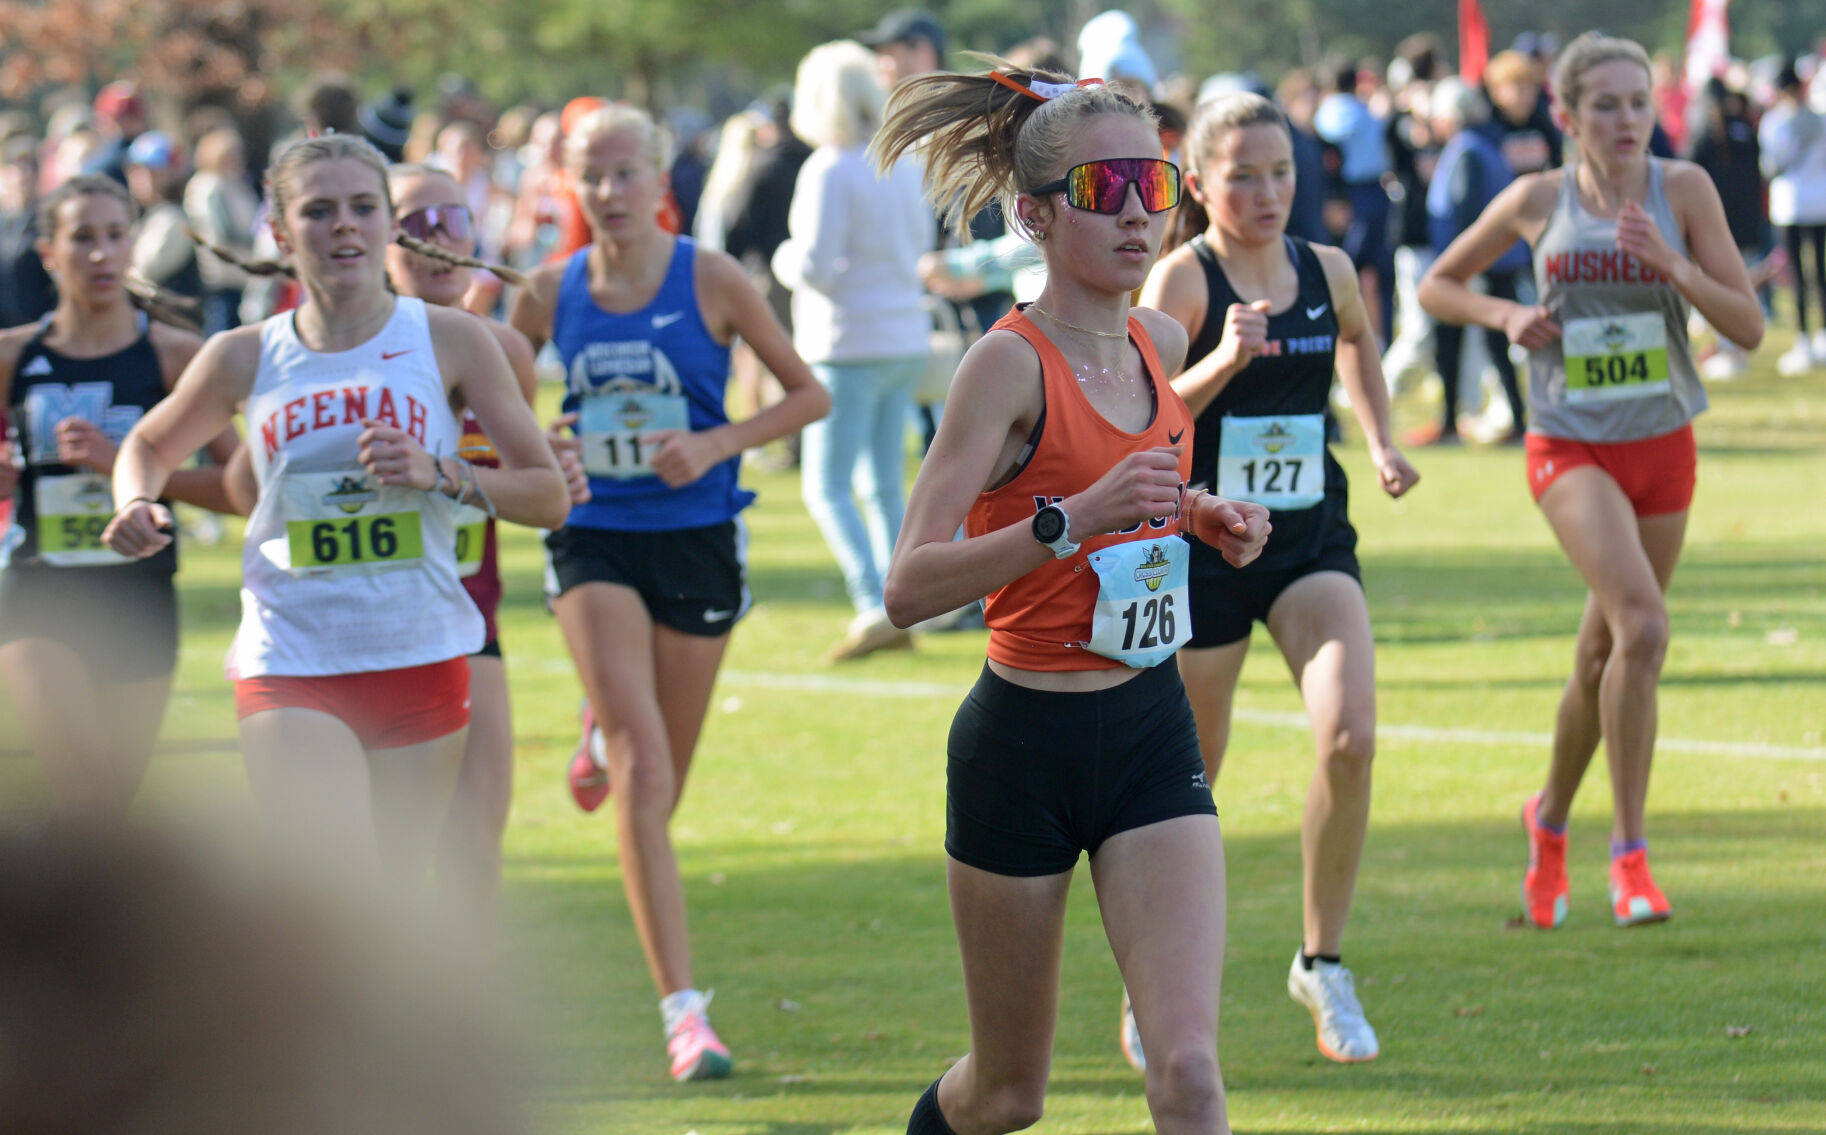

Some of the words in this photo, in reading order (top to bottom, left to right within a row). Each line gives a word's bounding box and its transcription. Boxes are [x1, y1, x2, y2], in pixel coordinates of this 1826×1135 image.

[1585, 353, 1648, 386] 504
[261, 386, 428, 464] NEENAH
[1242, 460, 1303, 493] 127
[312, 517, 398, 563] 616
[1122, 594, 1175, 650] 126
